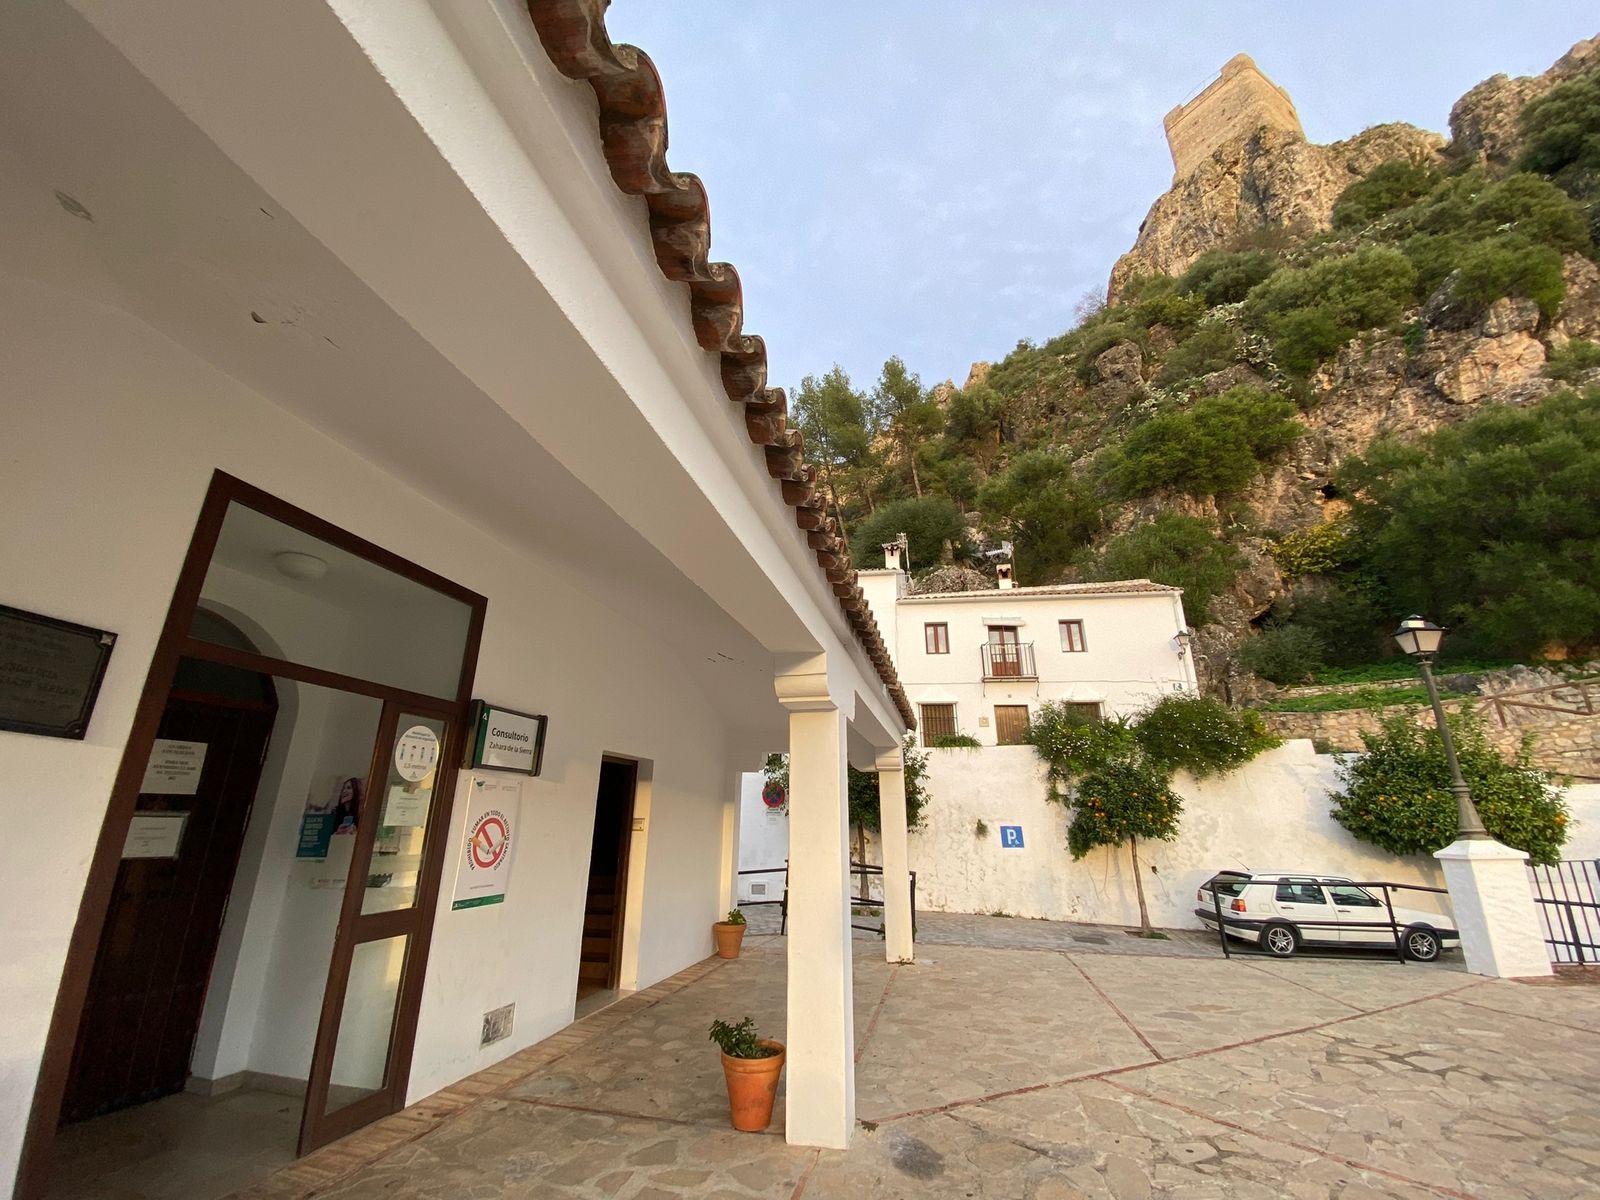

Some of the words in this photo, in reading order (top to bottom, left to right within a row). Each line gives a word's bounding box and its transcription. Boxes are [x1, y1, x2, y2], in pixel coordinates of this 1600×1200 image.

[491, 727, 529, 743] Consultorio
[489, 741, 507, 752] Zahara
[507, 744, 514, 752] de
[514, 745, 519, 753] la
[519, 746, 532, 755] Sierra
[466, 837, 476, 871] PROHIBIDO
[471, 815, 484, 834] FUMAR
[1006, 829, 1017, 845] P
